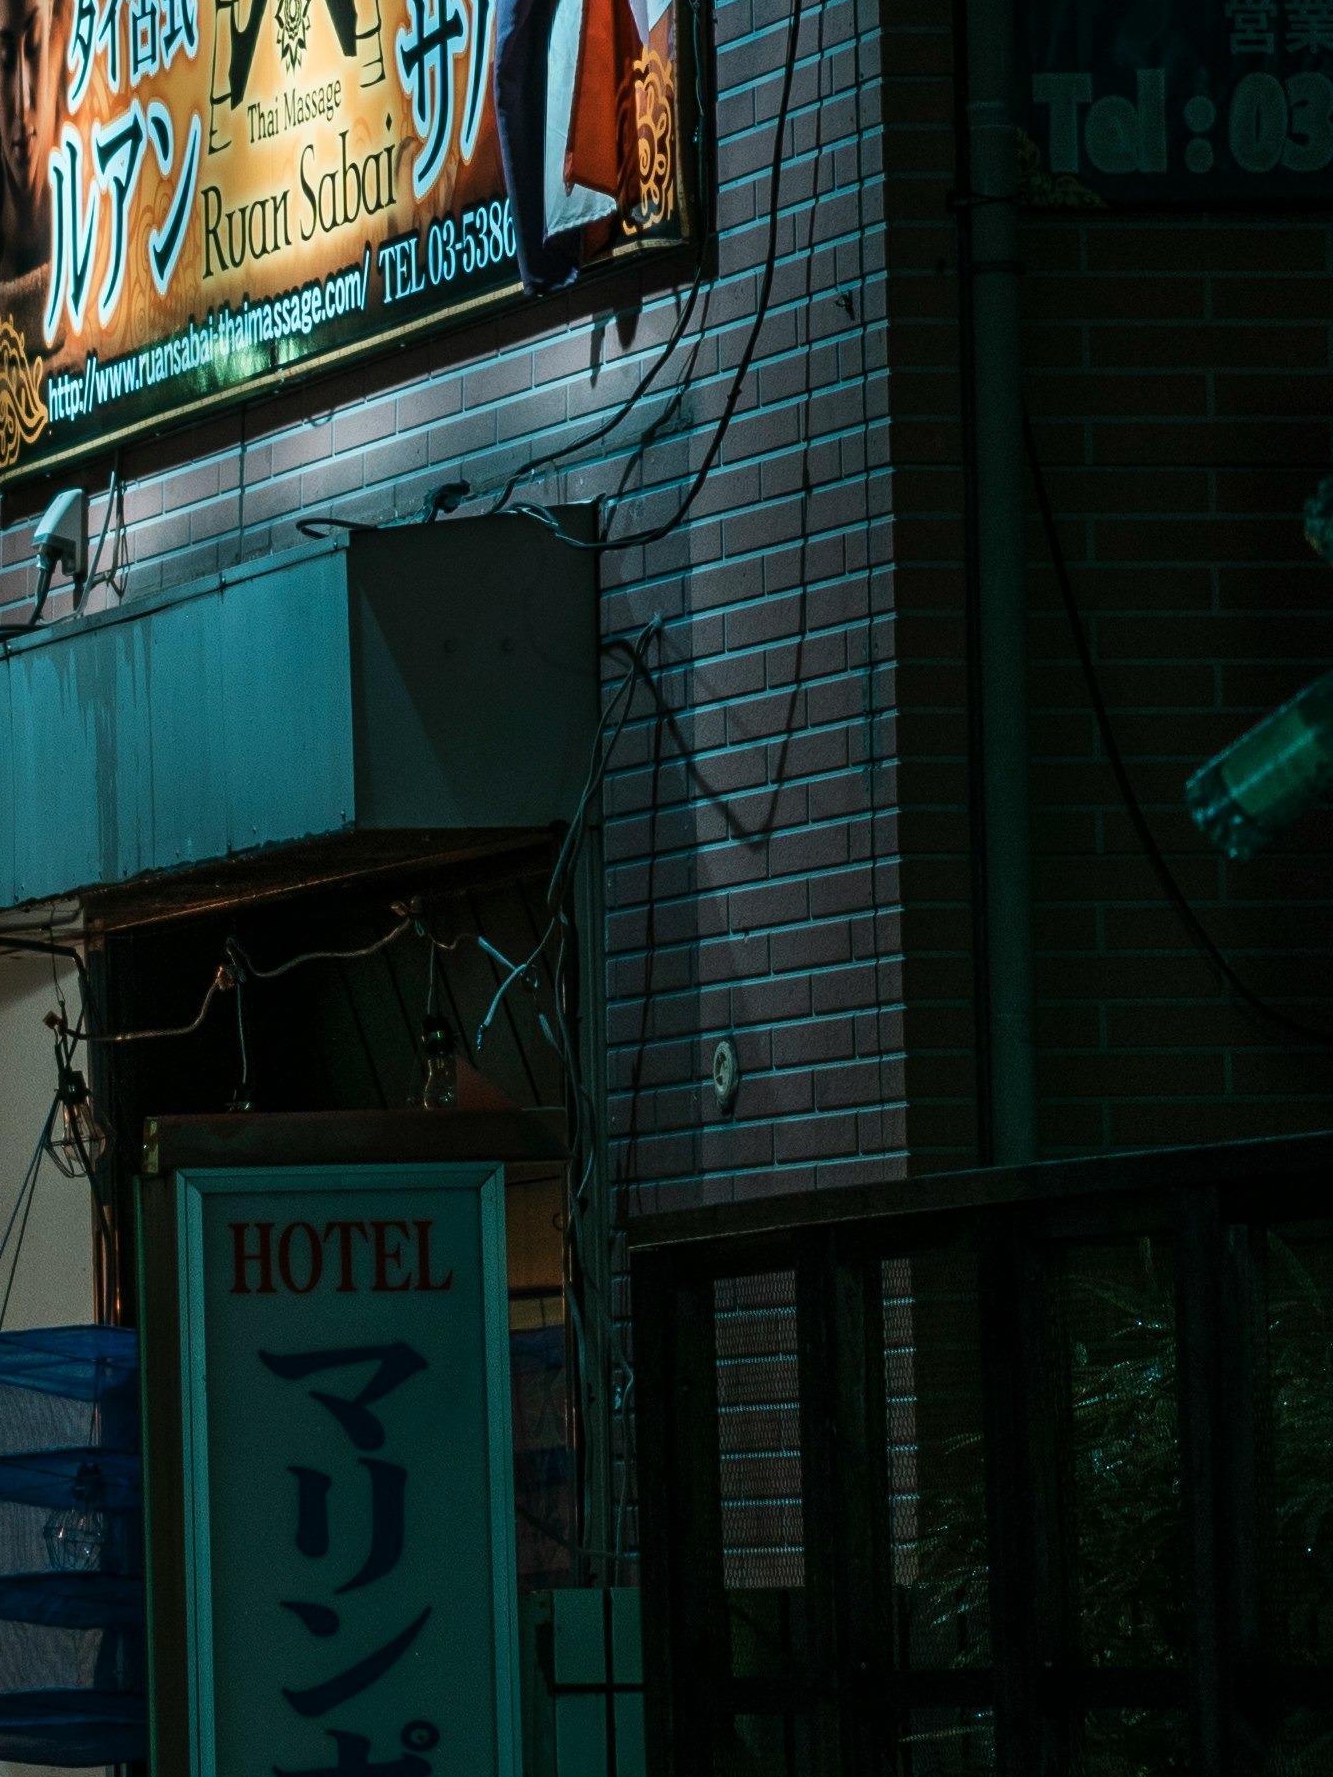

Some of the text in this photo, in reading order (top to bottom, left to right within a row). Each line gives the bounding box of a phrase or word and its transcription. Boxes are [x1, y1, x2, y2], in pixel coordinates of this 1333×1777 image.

[247, 78, 343, 145] Thai Massage
[47, 103, 200, 342] ルアン
[201, 114, 398, 281] Ruan Sabai
[379, 239, 426, 305] TEL
[47, 252, 370, 425] http://www.ruansabai-thaimassage.com/
[229, 1219, 454, 1295] HOTEL
